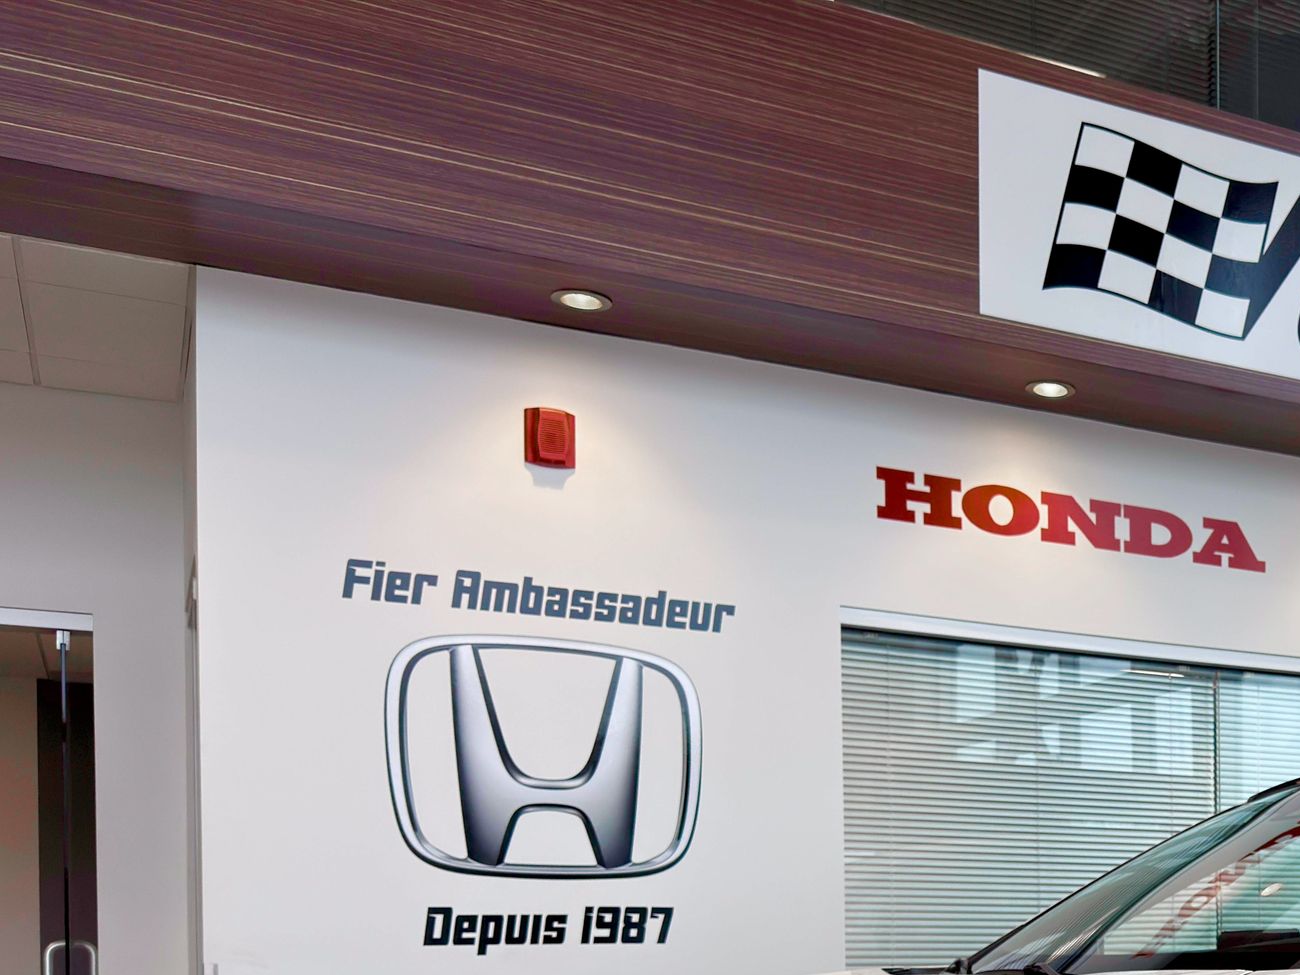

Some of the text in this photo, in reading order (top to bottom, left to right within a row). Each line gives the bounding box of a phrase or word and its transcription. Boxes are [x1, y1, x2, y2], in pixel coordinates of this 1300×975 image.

[876, 466, 1266, 573] HONDA
[342, 558, 736, 633] Fier Ambassadeur
[423, 906, 674, 956] Depuis 1987
